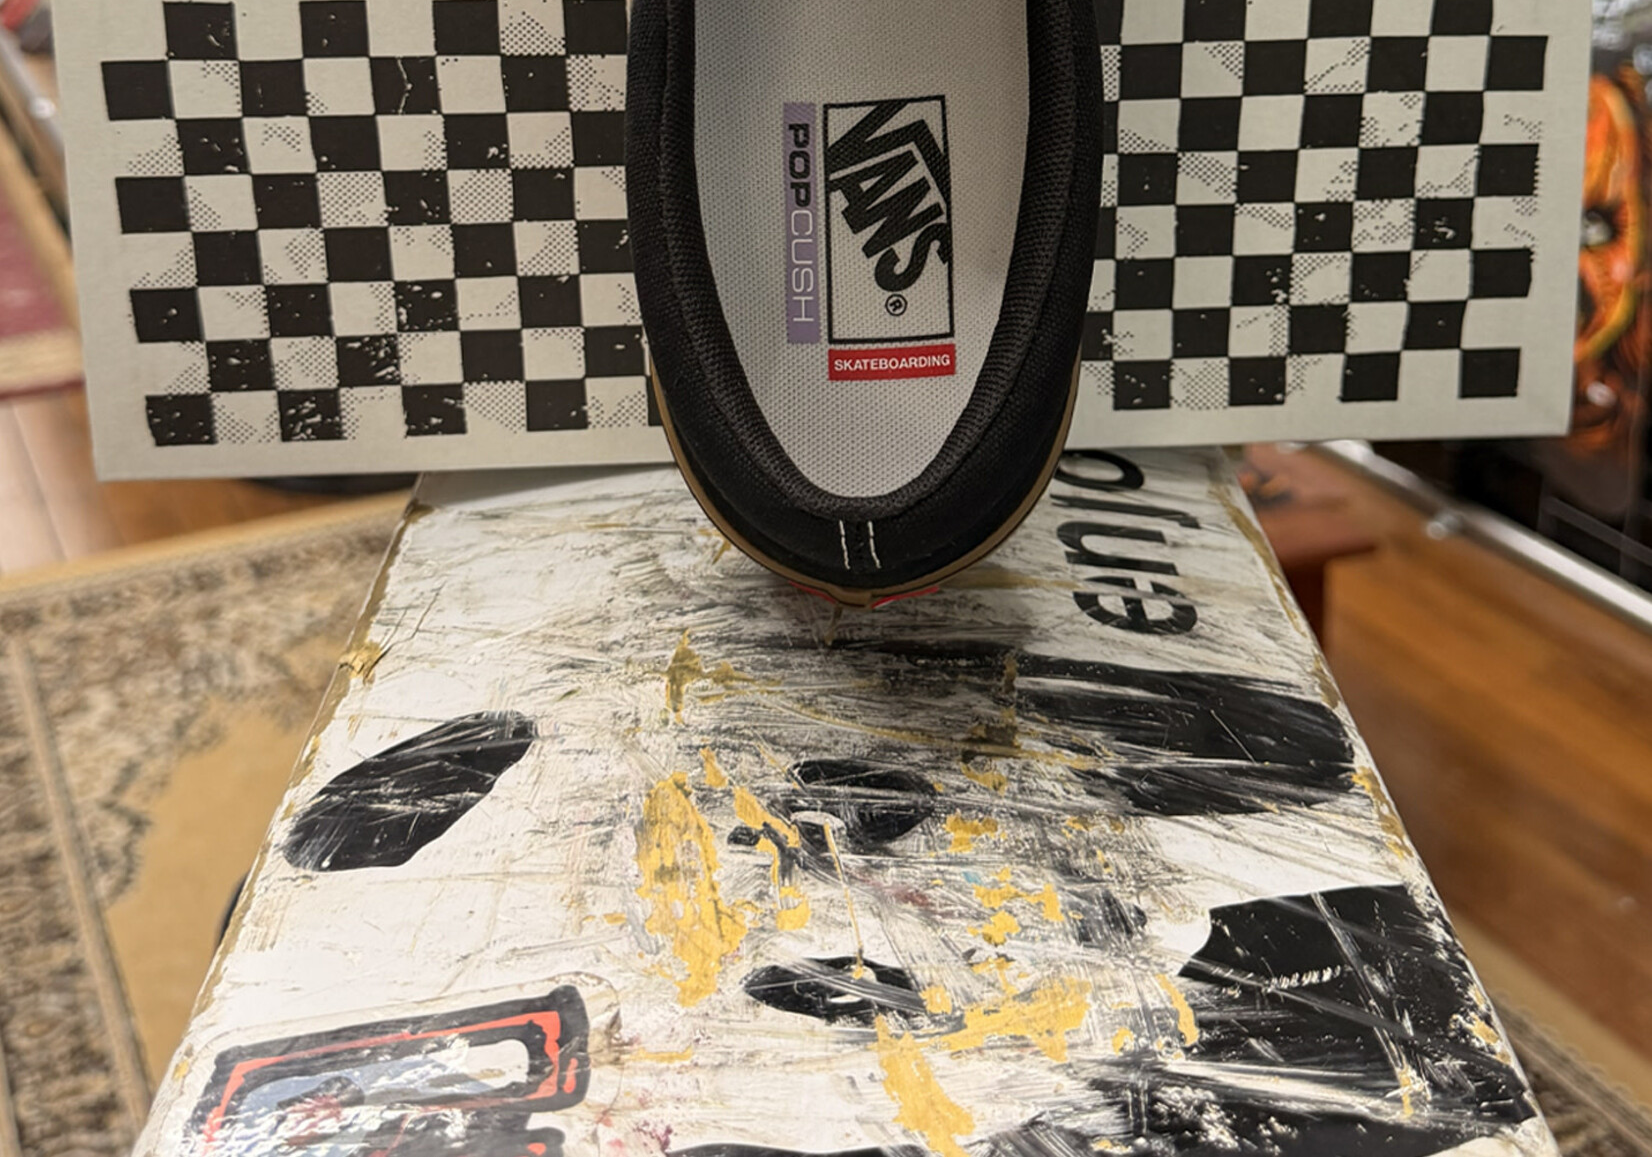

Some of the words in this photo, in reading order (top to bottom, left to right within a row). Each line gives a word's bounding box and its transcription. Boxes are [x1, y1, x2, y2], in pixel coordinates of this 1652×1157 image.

[789, 123, 814, 322] POPCUSH
[826, 98, 951, 293] VANS
[833, 354, 951, 373] SKATEBOARDING
